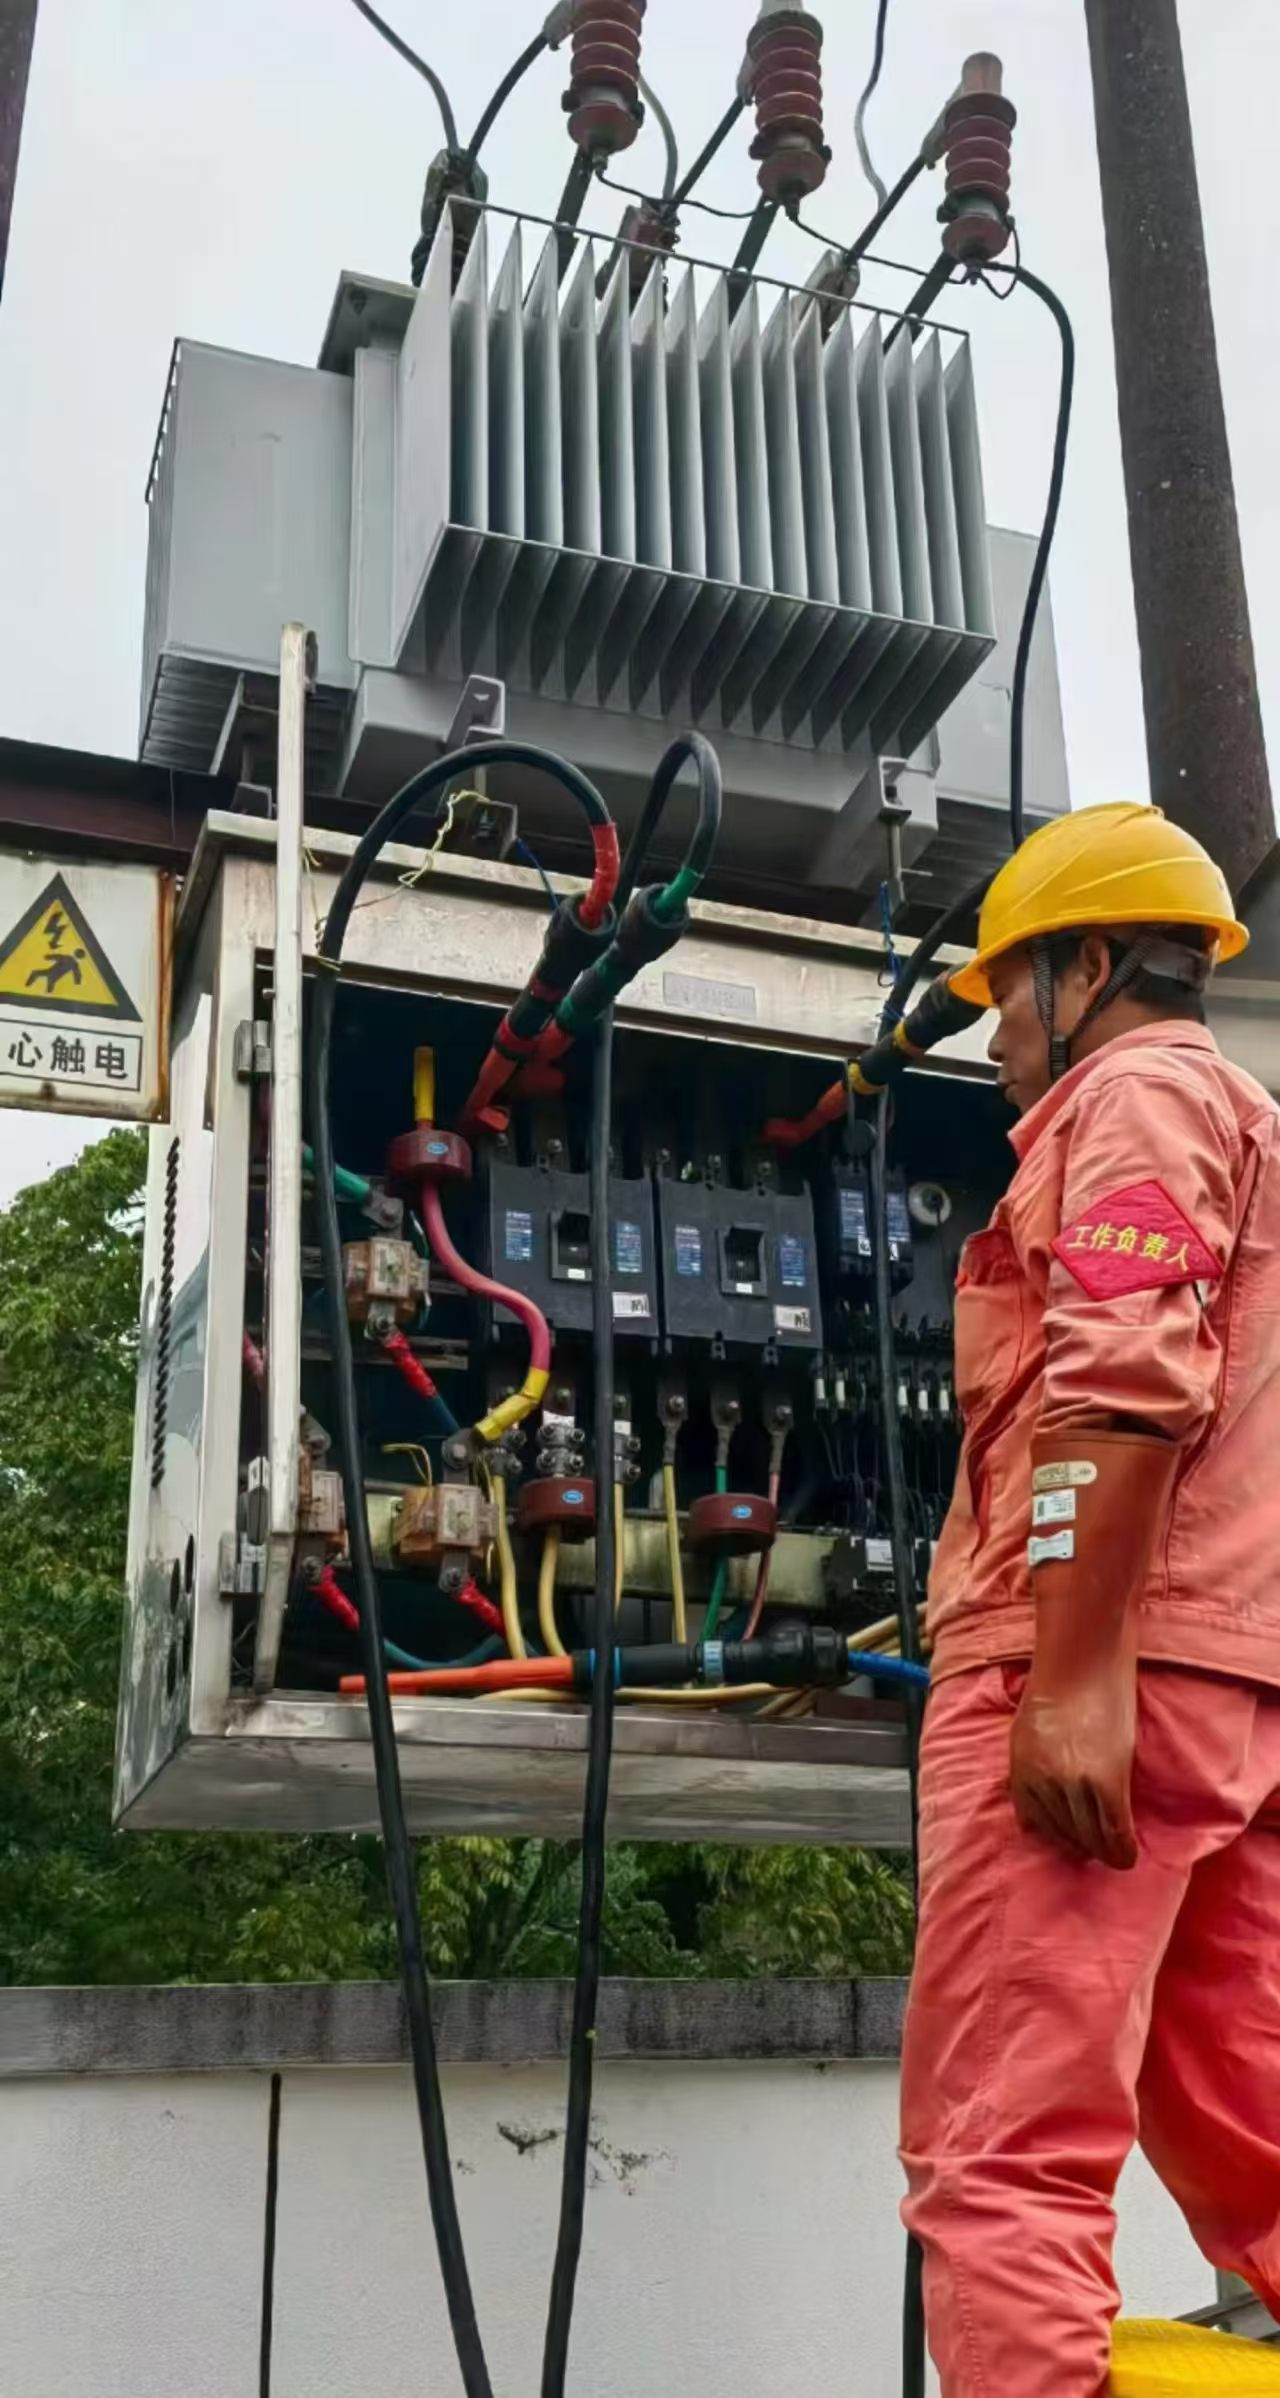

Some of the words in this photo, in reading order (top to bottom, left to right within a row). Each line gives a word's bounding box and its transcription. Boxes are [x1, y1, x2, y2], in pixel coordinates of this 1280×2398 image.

[8, 1031, 128, 1079] 心触电
[1066, 1222, 1189, 1271] 工作负责人
